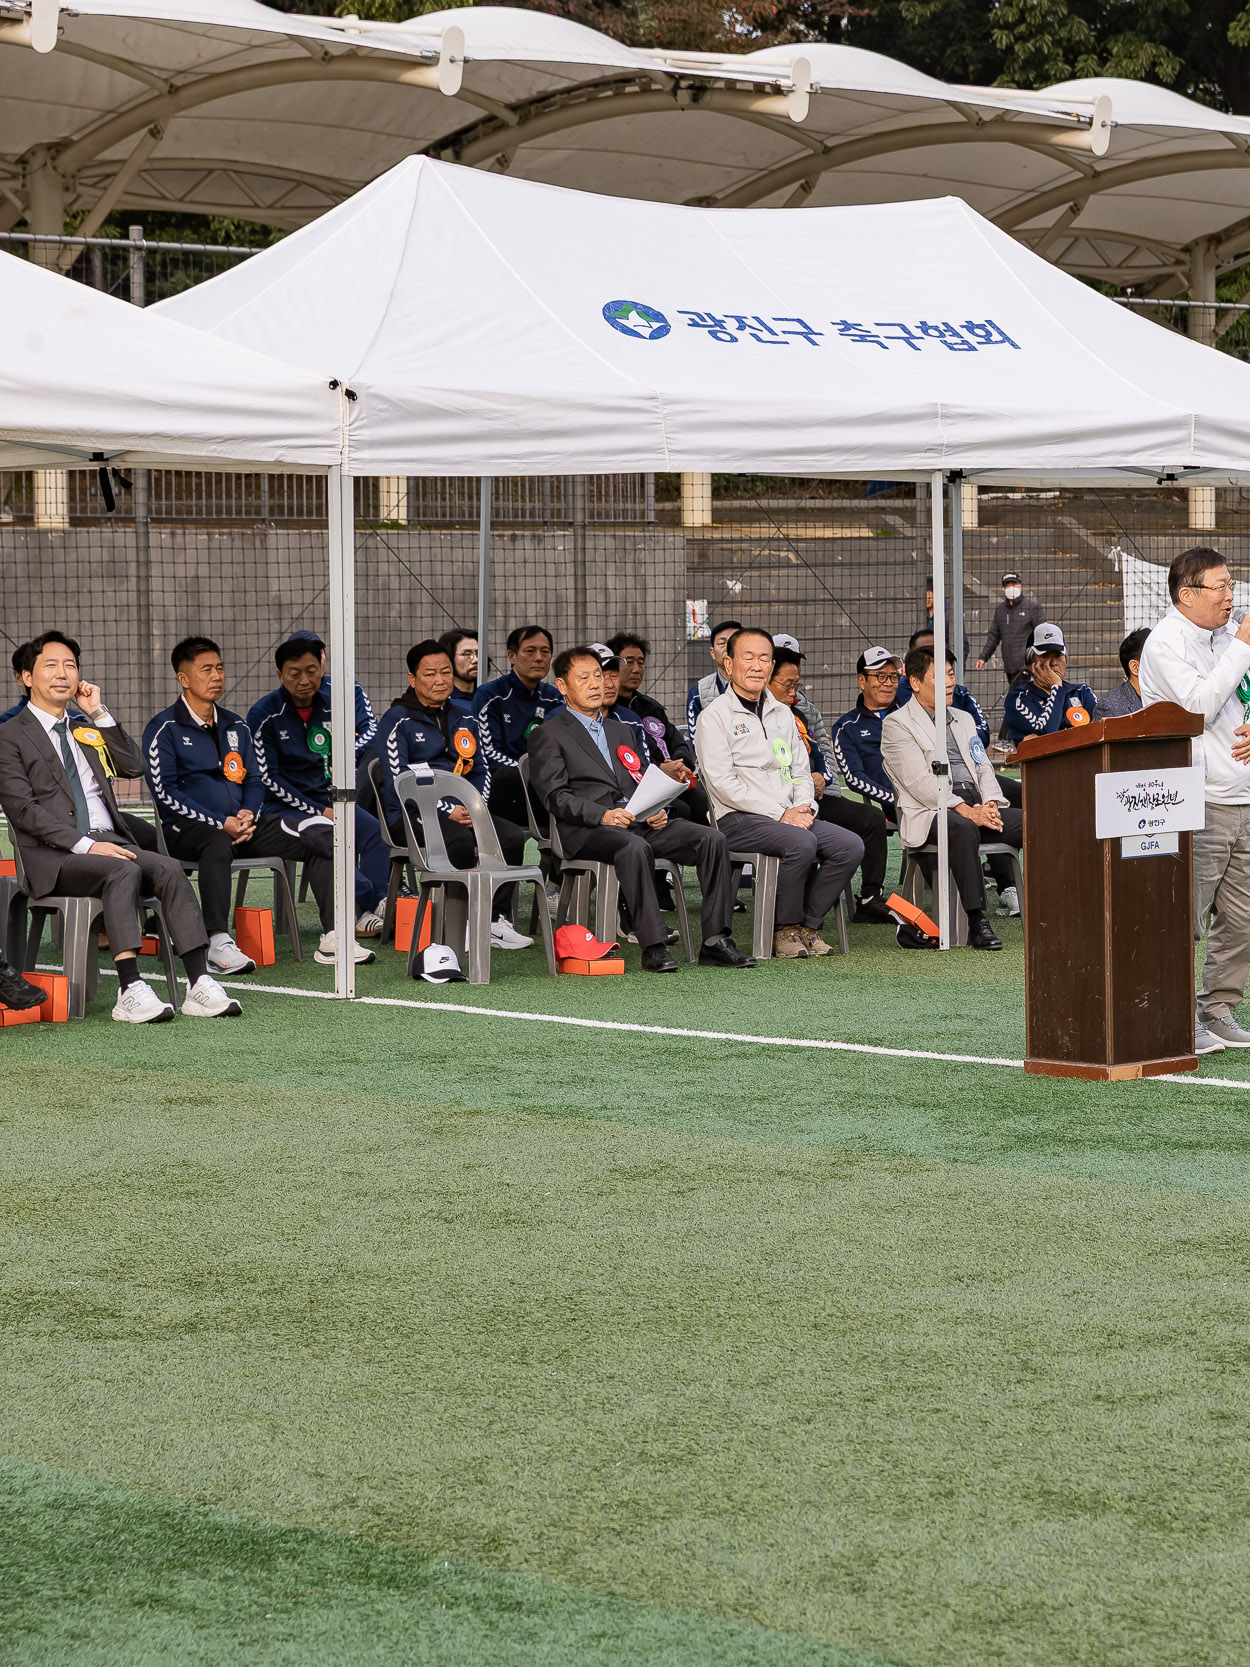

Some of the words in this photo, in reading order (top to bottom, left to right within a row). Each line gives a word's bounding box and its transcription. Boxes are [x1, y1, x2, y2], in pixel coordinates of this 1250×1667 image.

[676, 309, 826, 347] 광진구
[830, 318, 1022, 353] 축구협회
[1147, 819, 1165, 827] 광진구
[1140, 841, 1159, 850] GJFA
